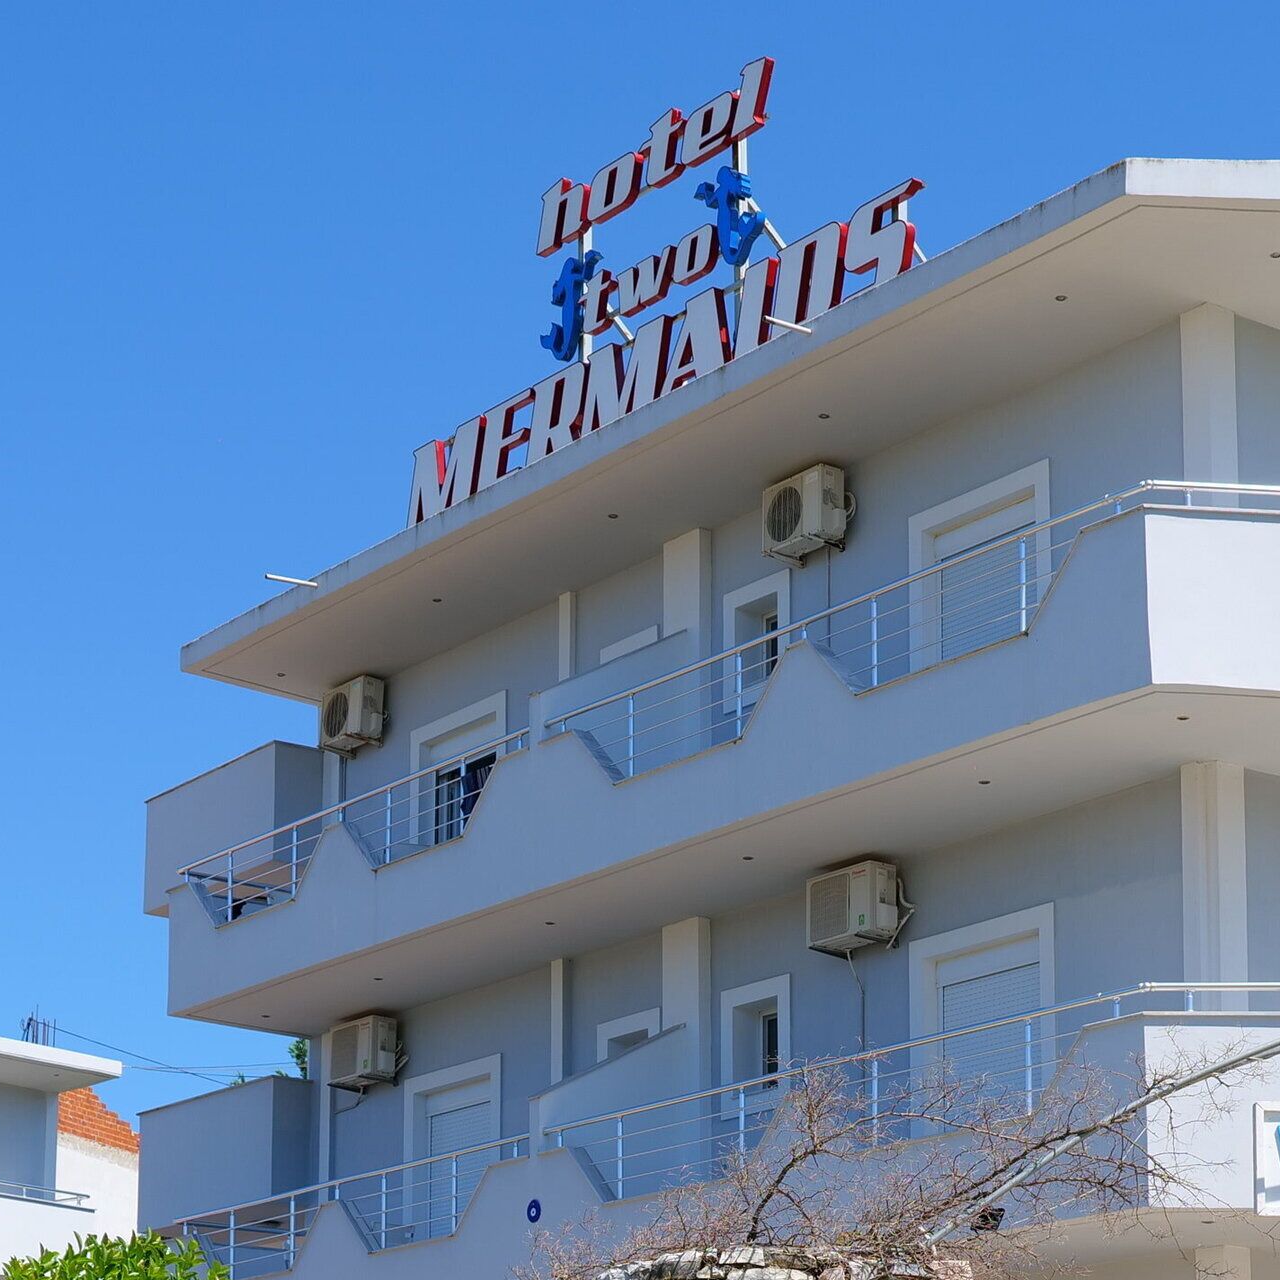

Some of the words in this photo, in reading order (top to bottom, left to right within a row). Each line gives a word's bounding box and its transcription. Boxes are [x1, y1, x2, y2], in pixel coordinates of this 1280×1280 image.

[536, 56, 775, 258] hotel
[407, 178, 926, 529] MERMAIDS
[579, 223, 721, 337] two
